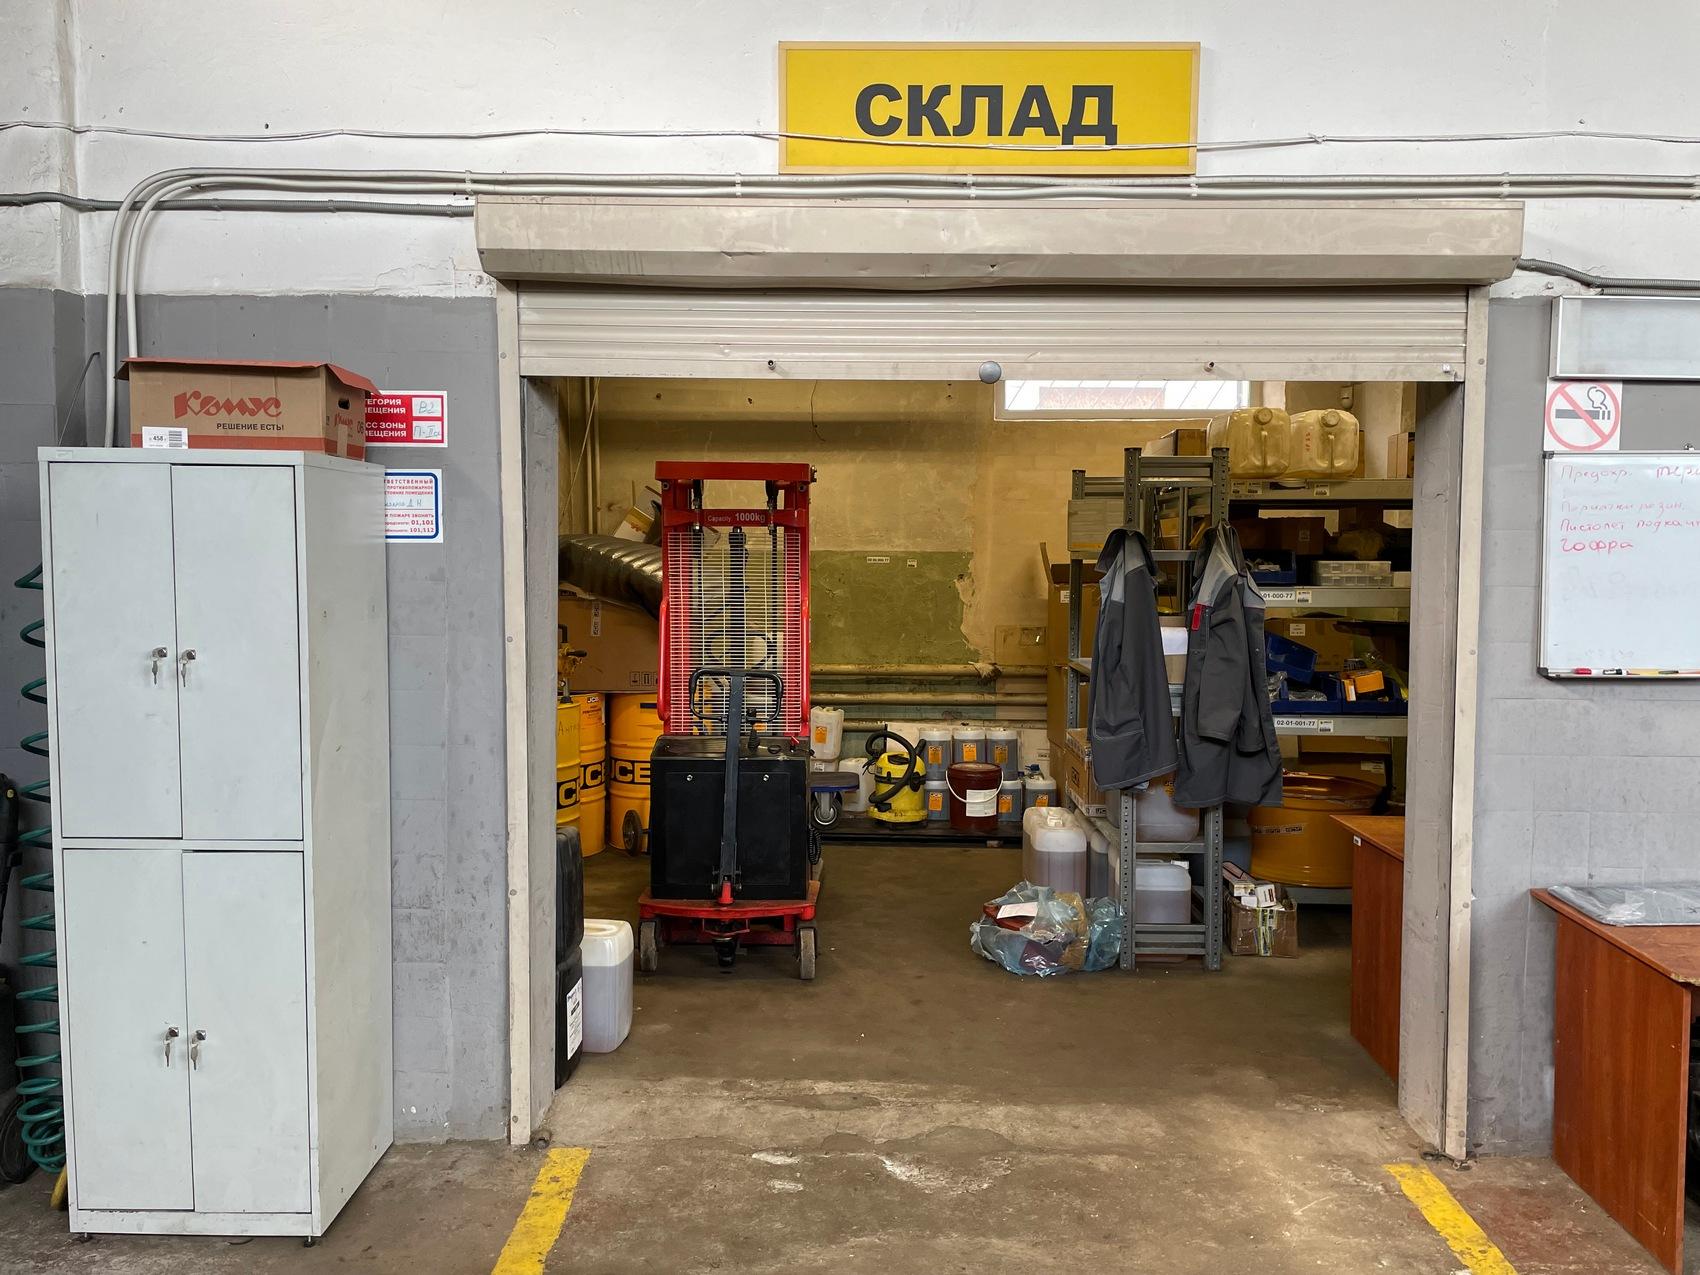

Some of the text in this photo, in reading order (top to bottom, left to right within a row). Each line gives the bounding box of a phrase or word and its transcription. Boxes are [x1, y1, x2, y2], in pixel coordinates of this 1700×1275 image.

[854, 83, 1118, 147] СКЛАД
[365, 407, 406, 415] ЕЩЕНИЯ
[216, 422, 285, 431] РЕШЕНИЕ ЕСТЬ!
[380, 421, 407, 429] ЗОНЫ
[735, 512, 766, 523] 1000kg
[1276, 719, 1316, 727] 02-01-001-77
